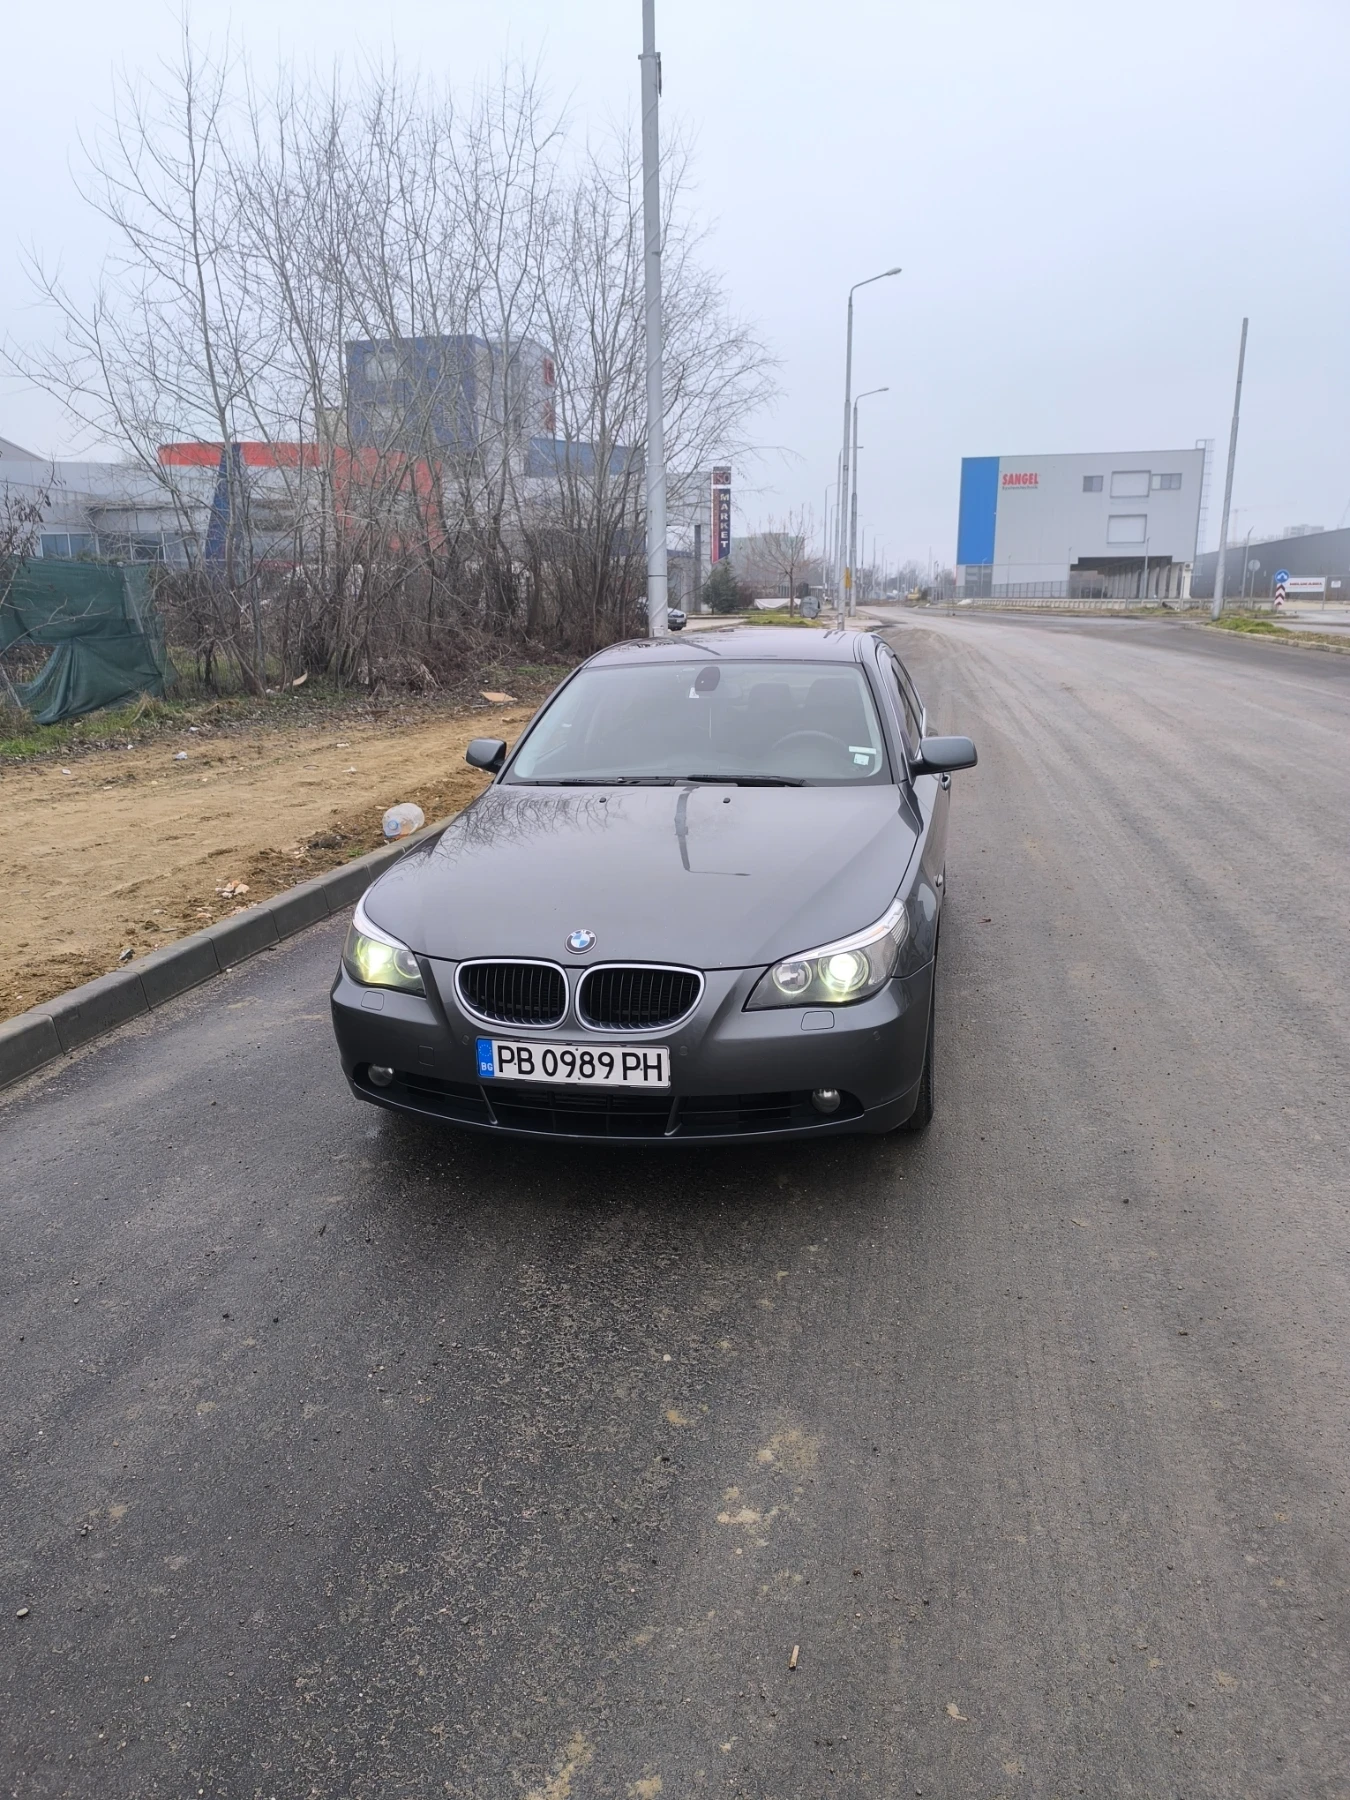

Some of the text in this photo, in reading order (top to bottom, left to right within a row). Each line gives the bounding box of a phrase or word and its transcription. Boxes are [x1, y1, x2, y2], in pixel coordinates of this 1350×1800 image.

[1002, 472, 1039, 486] SANGEL
[720, 493, 729, 548] MARKET
[481, 1062, 493, 1071] BG
[497, 1045, 662, 1082] PB 0989 PH
